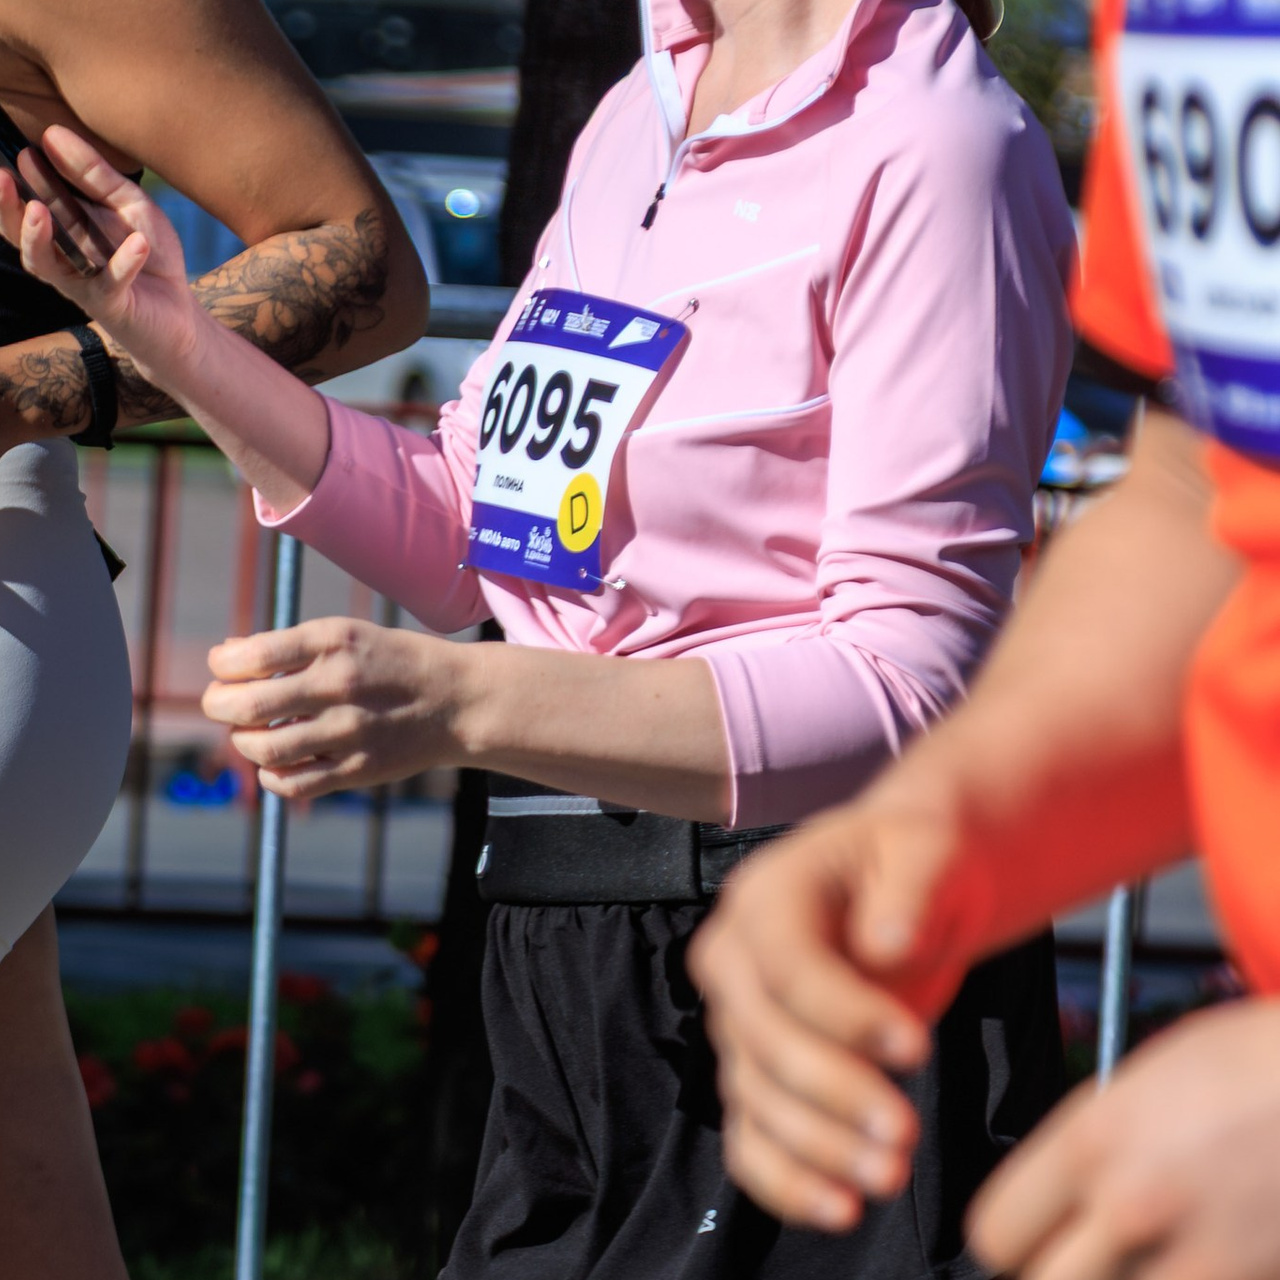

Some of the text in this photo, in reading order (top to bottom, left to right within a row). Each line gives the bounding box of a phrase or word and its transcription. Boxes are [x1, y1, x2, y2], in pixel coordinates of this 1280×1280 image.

[479, 361, 620, 470] 6095
[493, 474, 524, 493] ПОЛИНА
[570, 491, 589, 535] D
